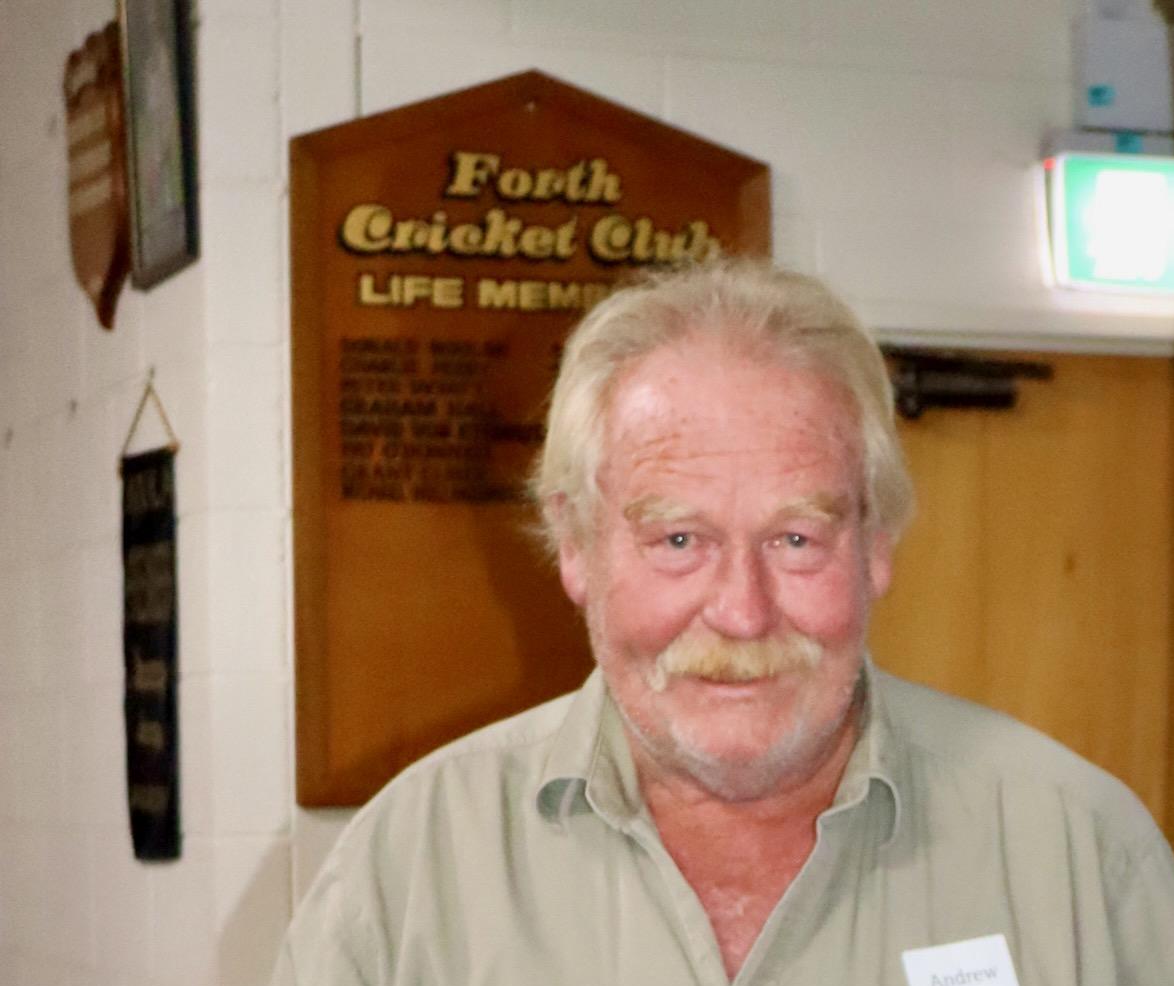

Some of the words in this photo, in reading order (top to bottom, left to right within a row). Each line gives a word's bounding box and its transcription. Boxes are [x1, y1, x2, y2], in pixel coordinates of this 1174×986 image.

[446, 150, 623, 204] Forth
[340, 204, 580, 262] Cricket
[588, 214, 722, 268] Club
[358, 273, 465, 308] LIFE
